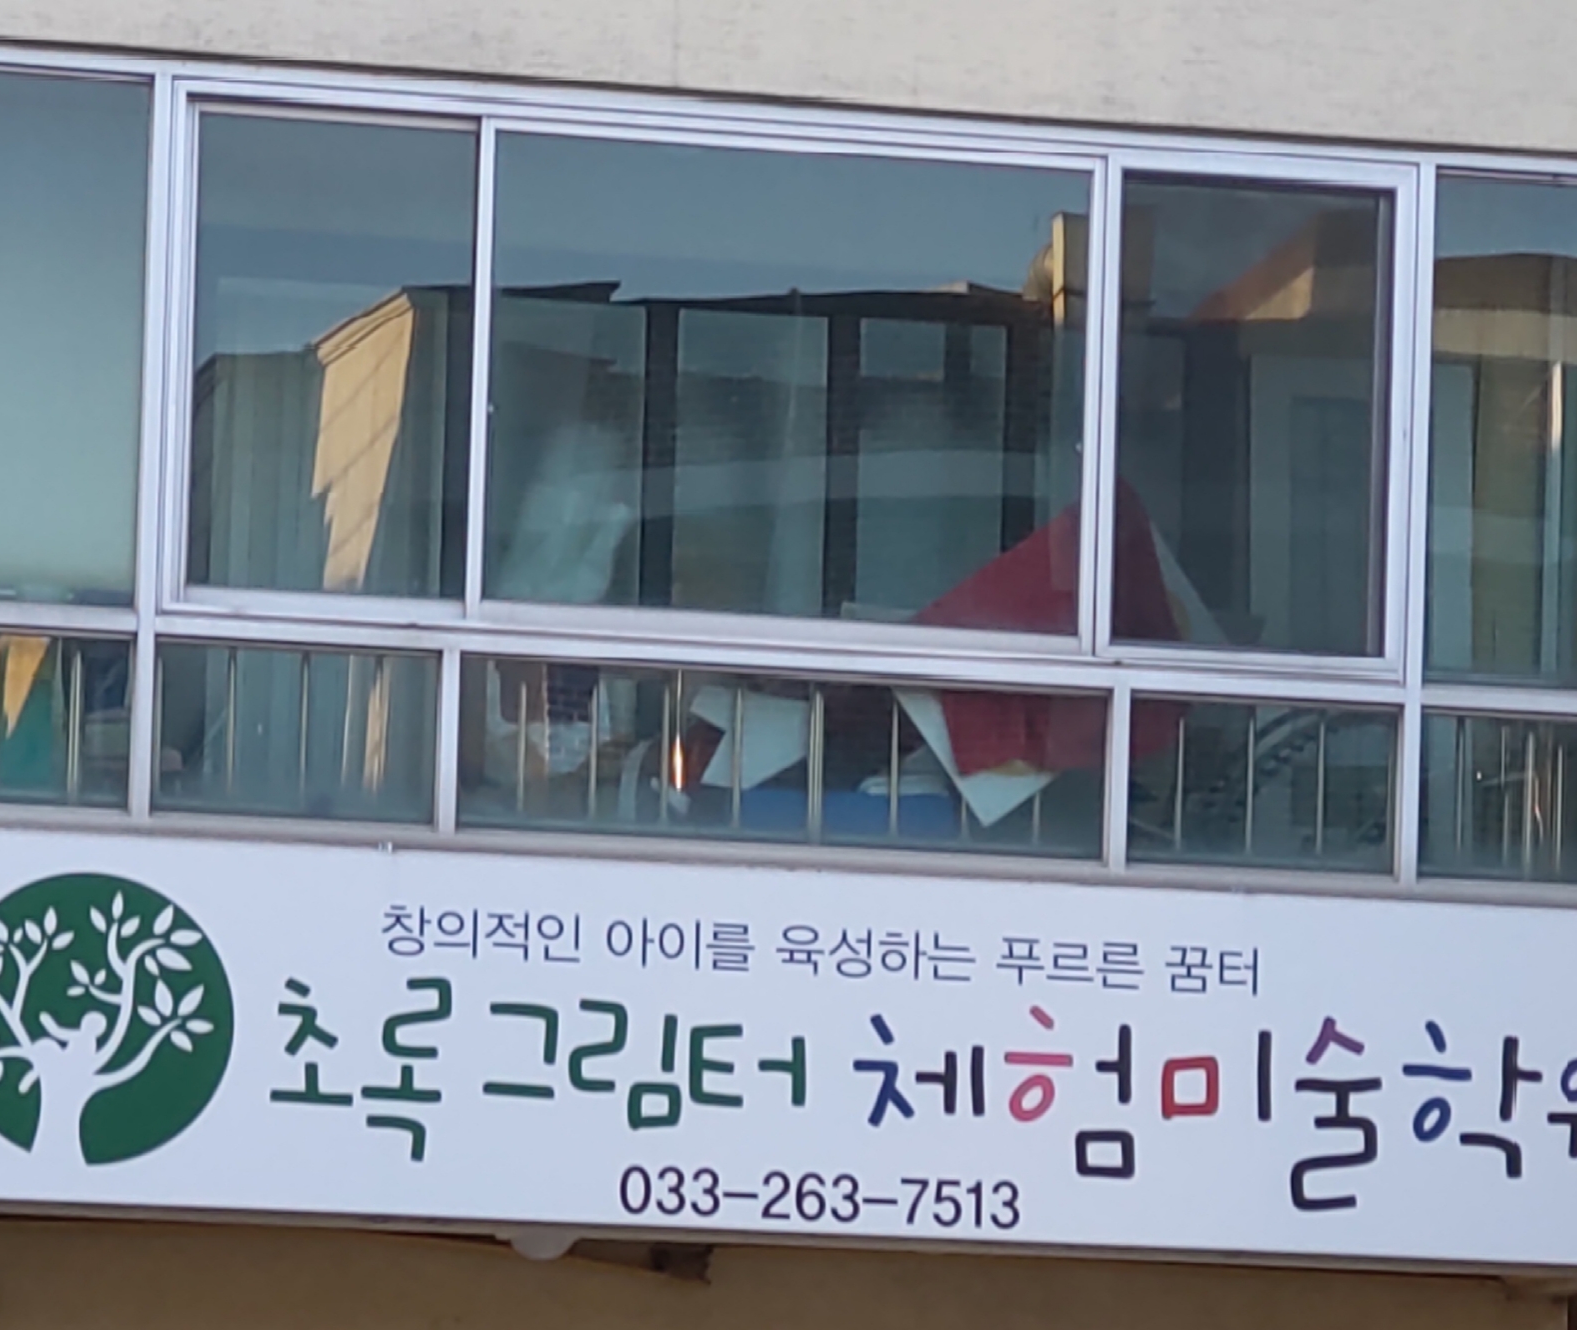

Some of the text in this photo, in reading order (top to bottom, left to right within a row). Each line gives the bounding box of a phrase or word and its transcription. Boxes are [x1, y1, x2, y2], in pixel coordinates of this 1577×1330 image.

[382, 905, 1260, 997] 창의적인 아이를 육성하는 푸르른 꿈터
[619, 1165, 1020, 1230] 033-263-7513
